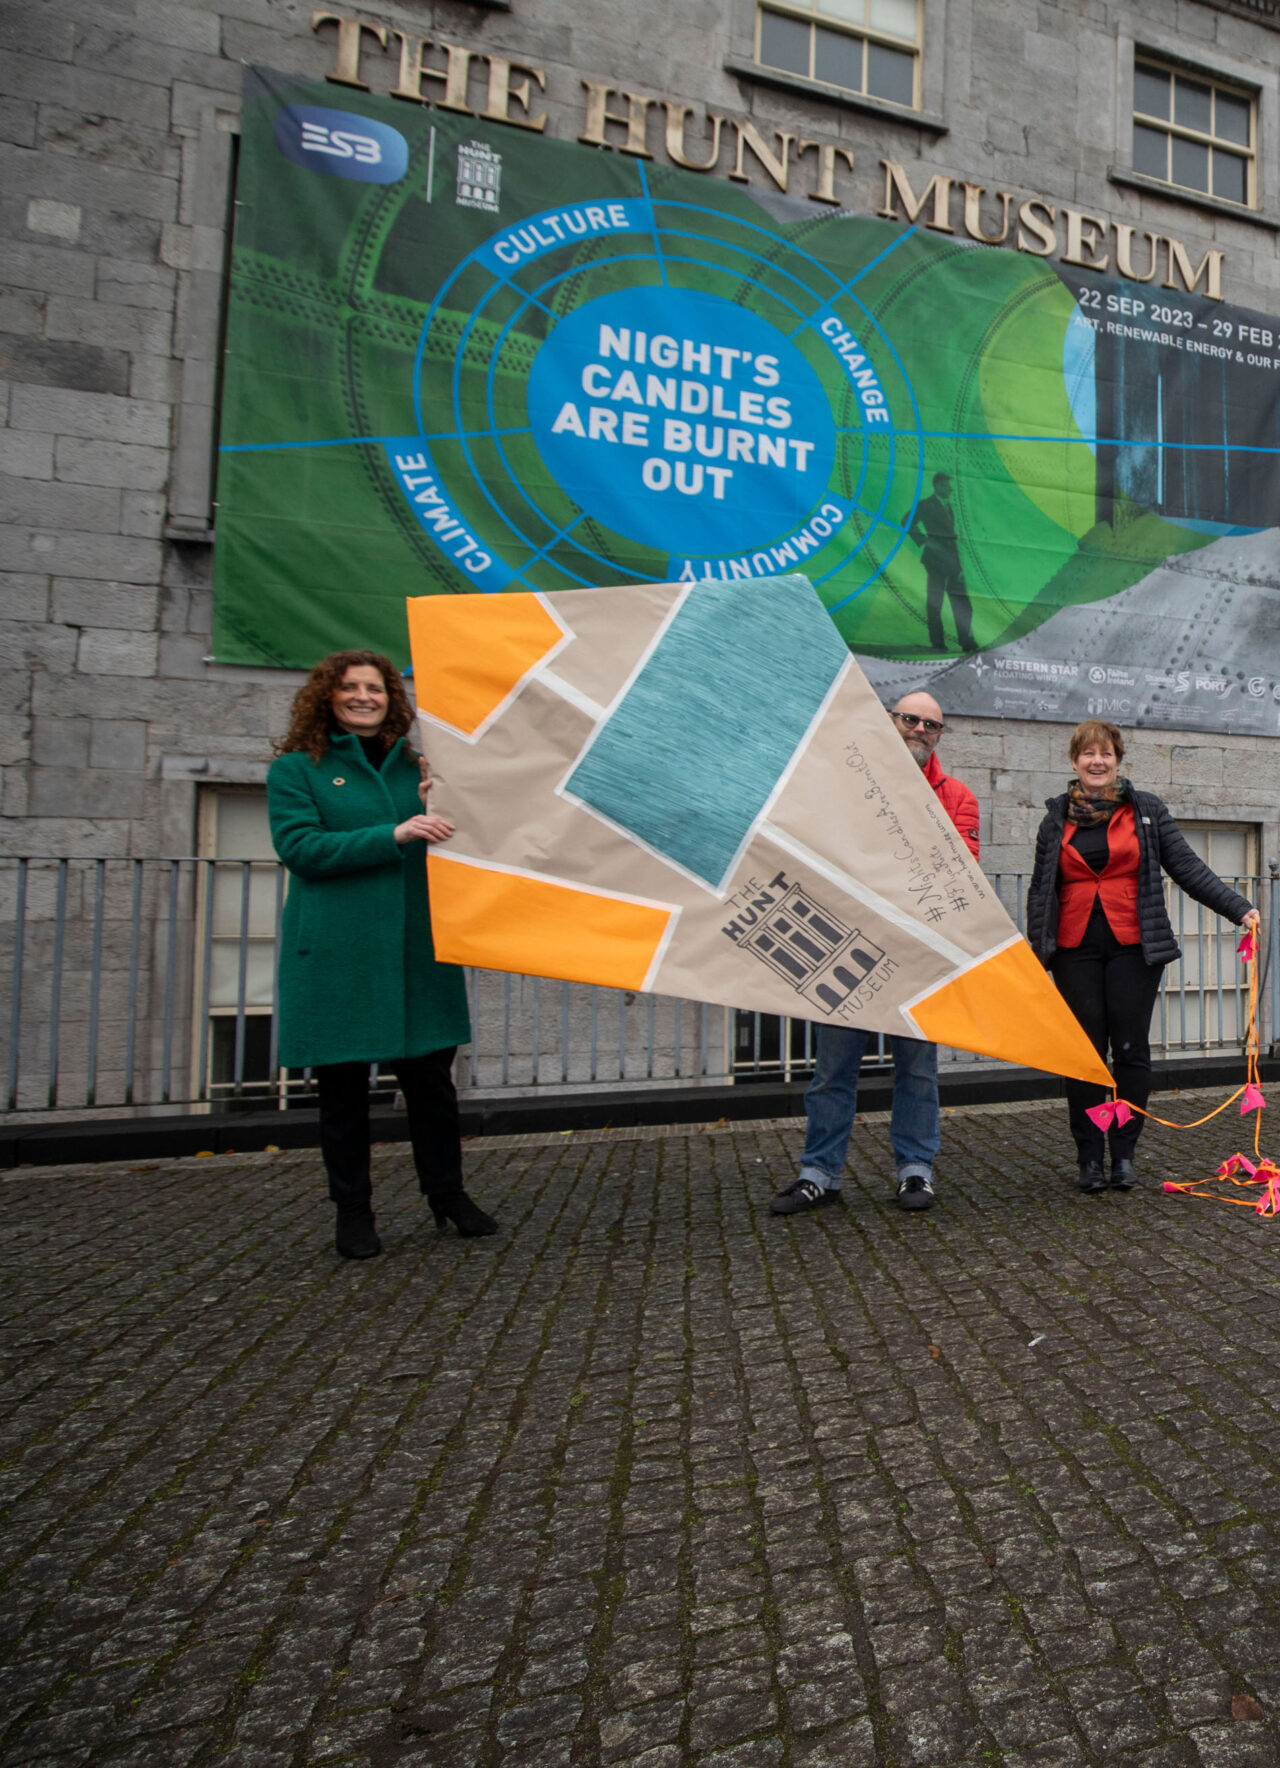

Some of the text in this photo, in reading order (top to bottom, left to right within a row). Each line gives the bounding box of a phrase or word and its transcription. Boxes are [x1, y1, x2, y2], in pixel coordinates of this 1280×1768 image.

[301, 120, 383, 165] ESB
[312, 10, 1226, 302] THE HUNT MUSEUM
[458, 143, 503, 164] HUNT
[493, 203, 631, 265] CULTURE
[1074, 315, 1103, 332] ART,
[1106, 321, 1183, 349] RENEWABLE
[1186, 339, 1233, 361] ENERGY
[1235, 351, 1244, 363] &
[1246, 353, 1272, 369] OUR
[1079, 287, 1101, 309] 22
[1106, 294, 1145, 317] SEP
[1150, 303, 1194, 329] 2023
[1212, 319, 1233, 338] 29
[1238, 323, 1273, 347] FEB
[581, 363, 792, 430] CANDLES
[820, 316, 890, 424] CHANGE
[551, 400, 815, 473] ARE BURNT
[642, 457, 734, 500] OUT
[394, 452, 492, 574] CLIMATE
[678, 503, 843, 582] COMMUNITY
[993, 658, 1079, 677] WESTERN STAR
[993, 670, 1058, 682] FLOATING WIND
[1103, 697, 1131, 713] MIC
[720, 870, 790, 943] HUNT
[723, 875, 766, 910] THE
[836, 957, 900, 1022] MUSEUM
